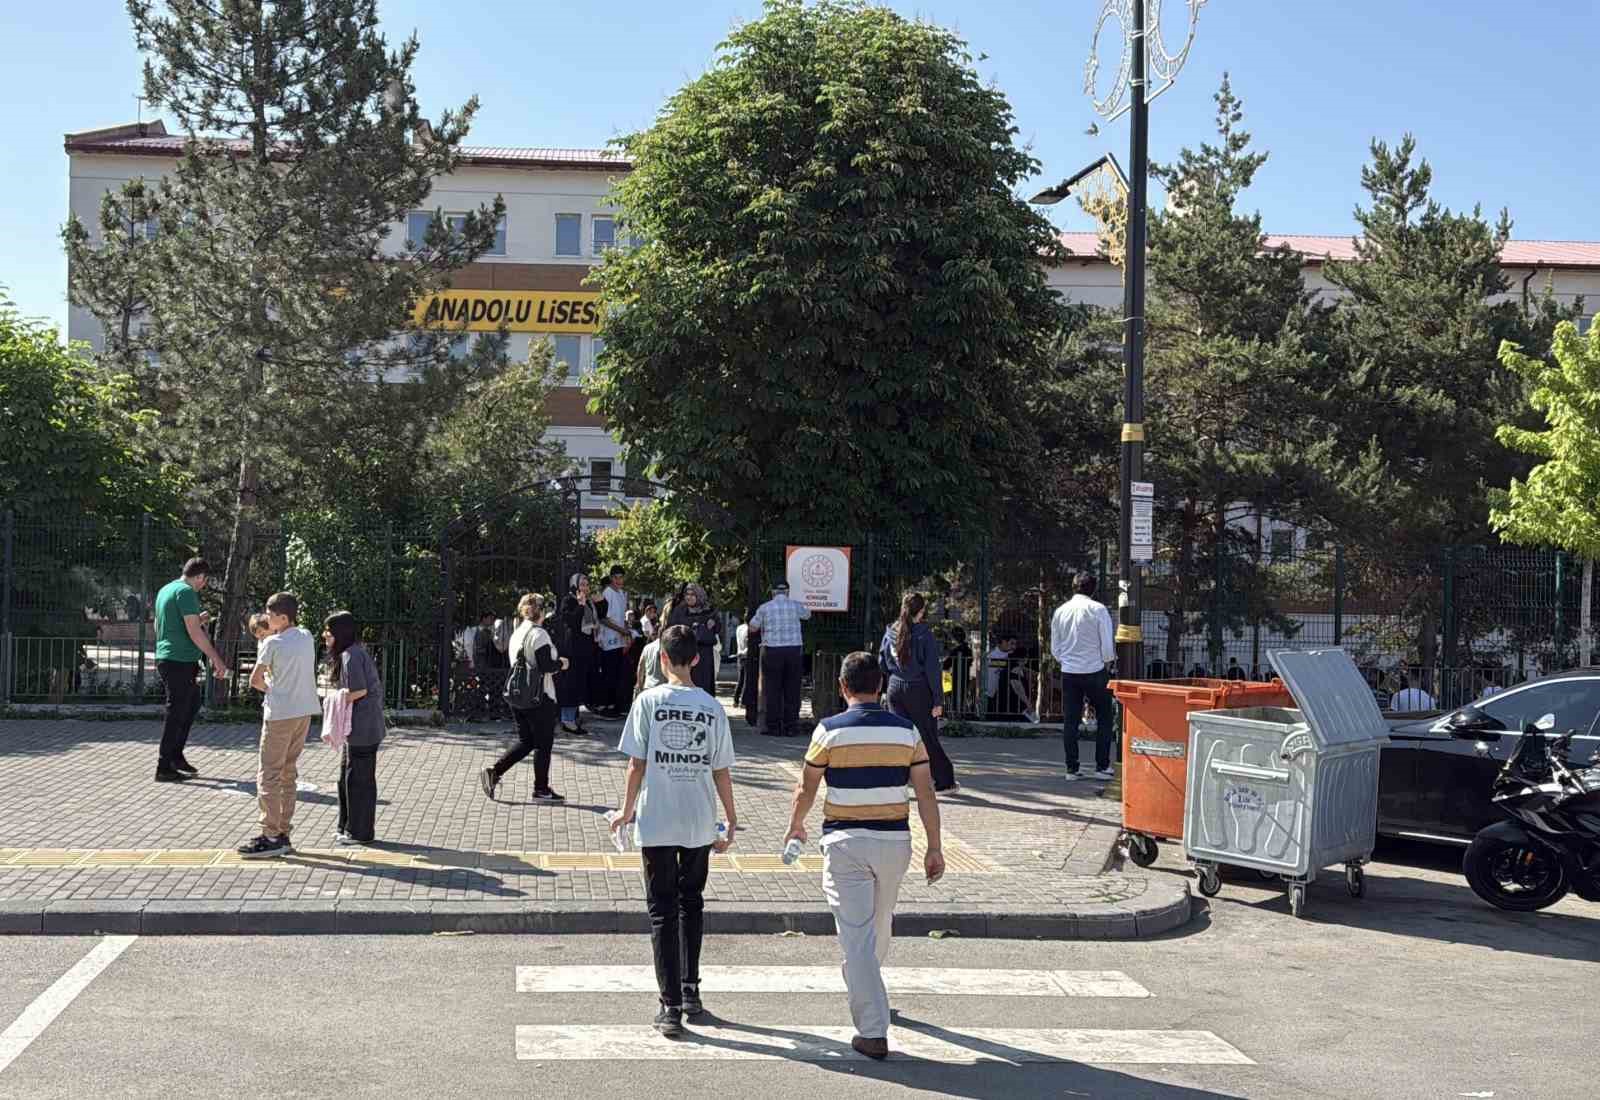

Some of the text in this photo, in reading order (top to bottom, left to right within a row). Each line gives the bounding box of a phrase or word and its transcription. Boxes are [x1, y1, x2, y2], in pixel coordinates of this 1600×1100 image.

[424, 298, 531, 324] ANADOLU
[655, 709, 715, 727] GREAT
[655, 750, 712, 766] MINDS
